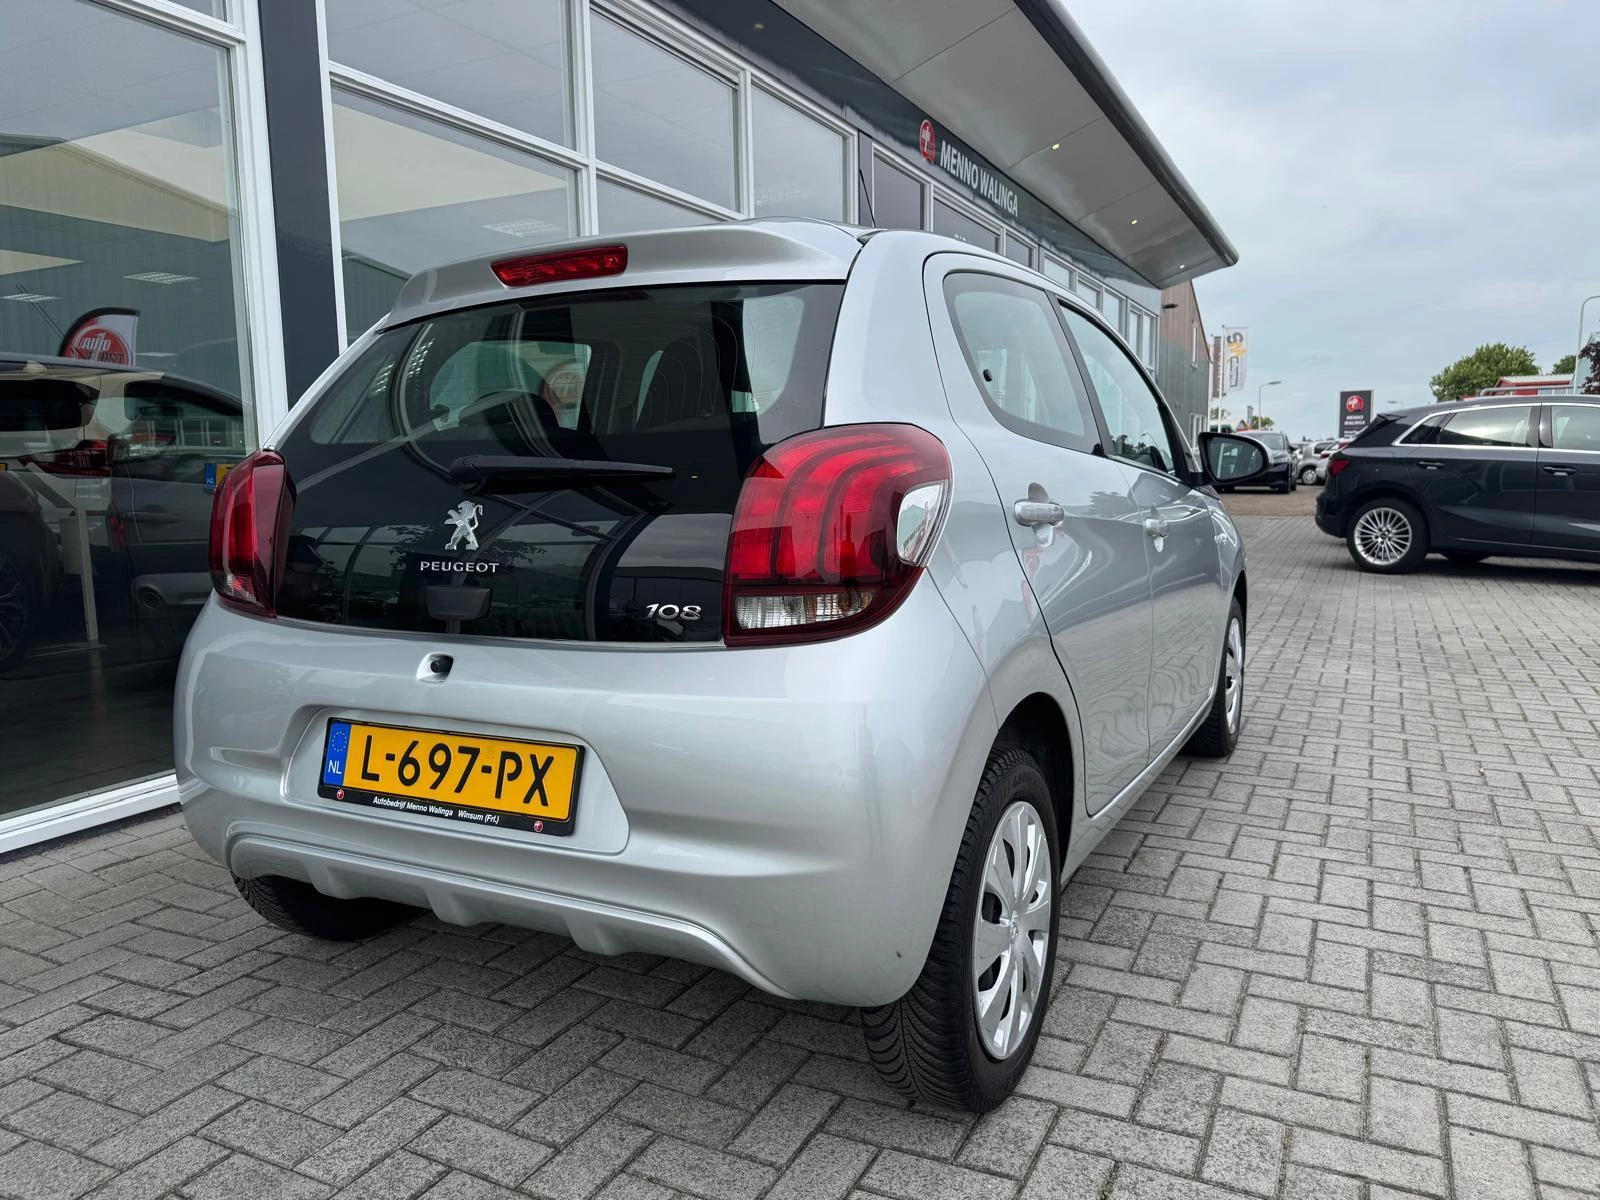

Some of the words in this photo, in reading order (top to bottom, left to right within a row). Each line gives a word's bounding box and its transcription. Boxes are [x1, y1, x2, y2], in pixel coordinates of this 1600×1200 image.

[940, 140, 979, 189] MENNO
[980, 169, 1018, 217] WALINGA
[420, 561, 500, 574] PEUGEOT
[646, 603, 701, 621] 108
[328, 760, 342, 775] NL
[361, 734, 554, 807] L-697-PX
[372, 796, 406, 810] Autobedrijf
[406, 801, 428, 812] Menno
[428, 805, 454, 817] Walinga
[458, 809, 484, 821] Winsum
[484, 813, 500, 825] (Frl.)
